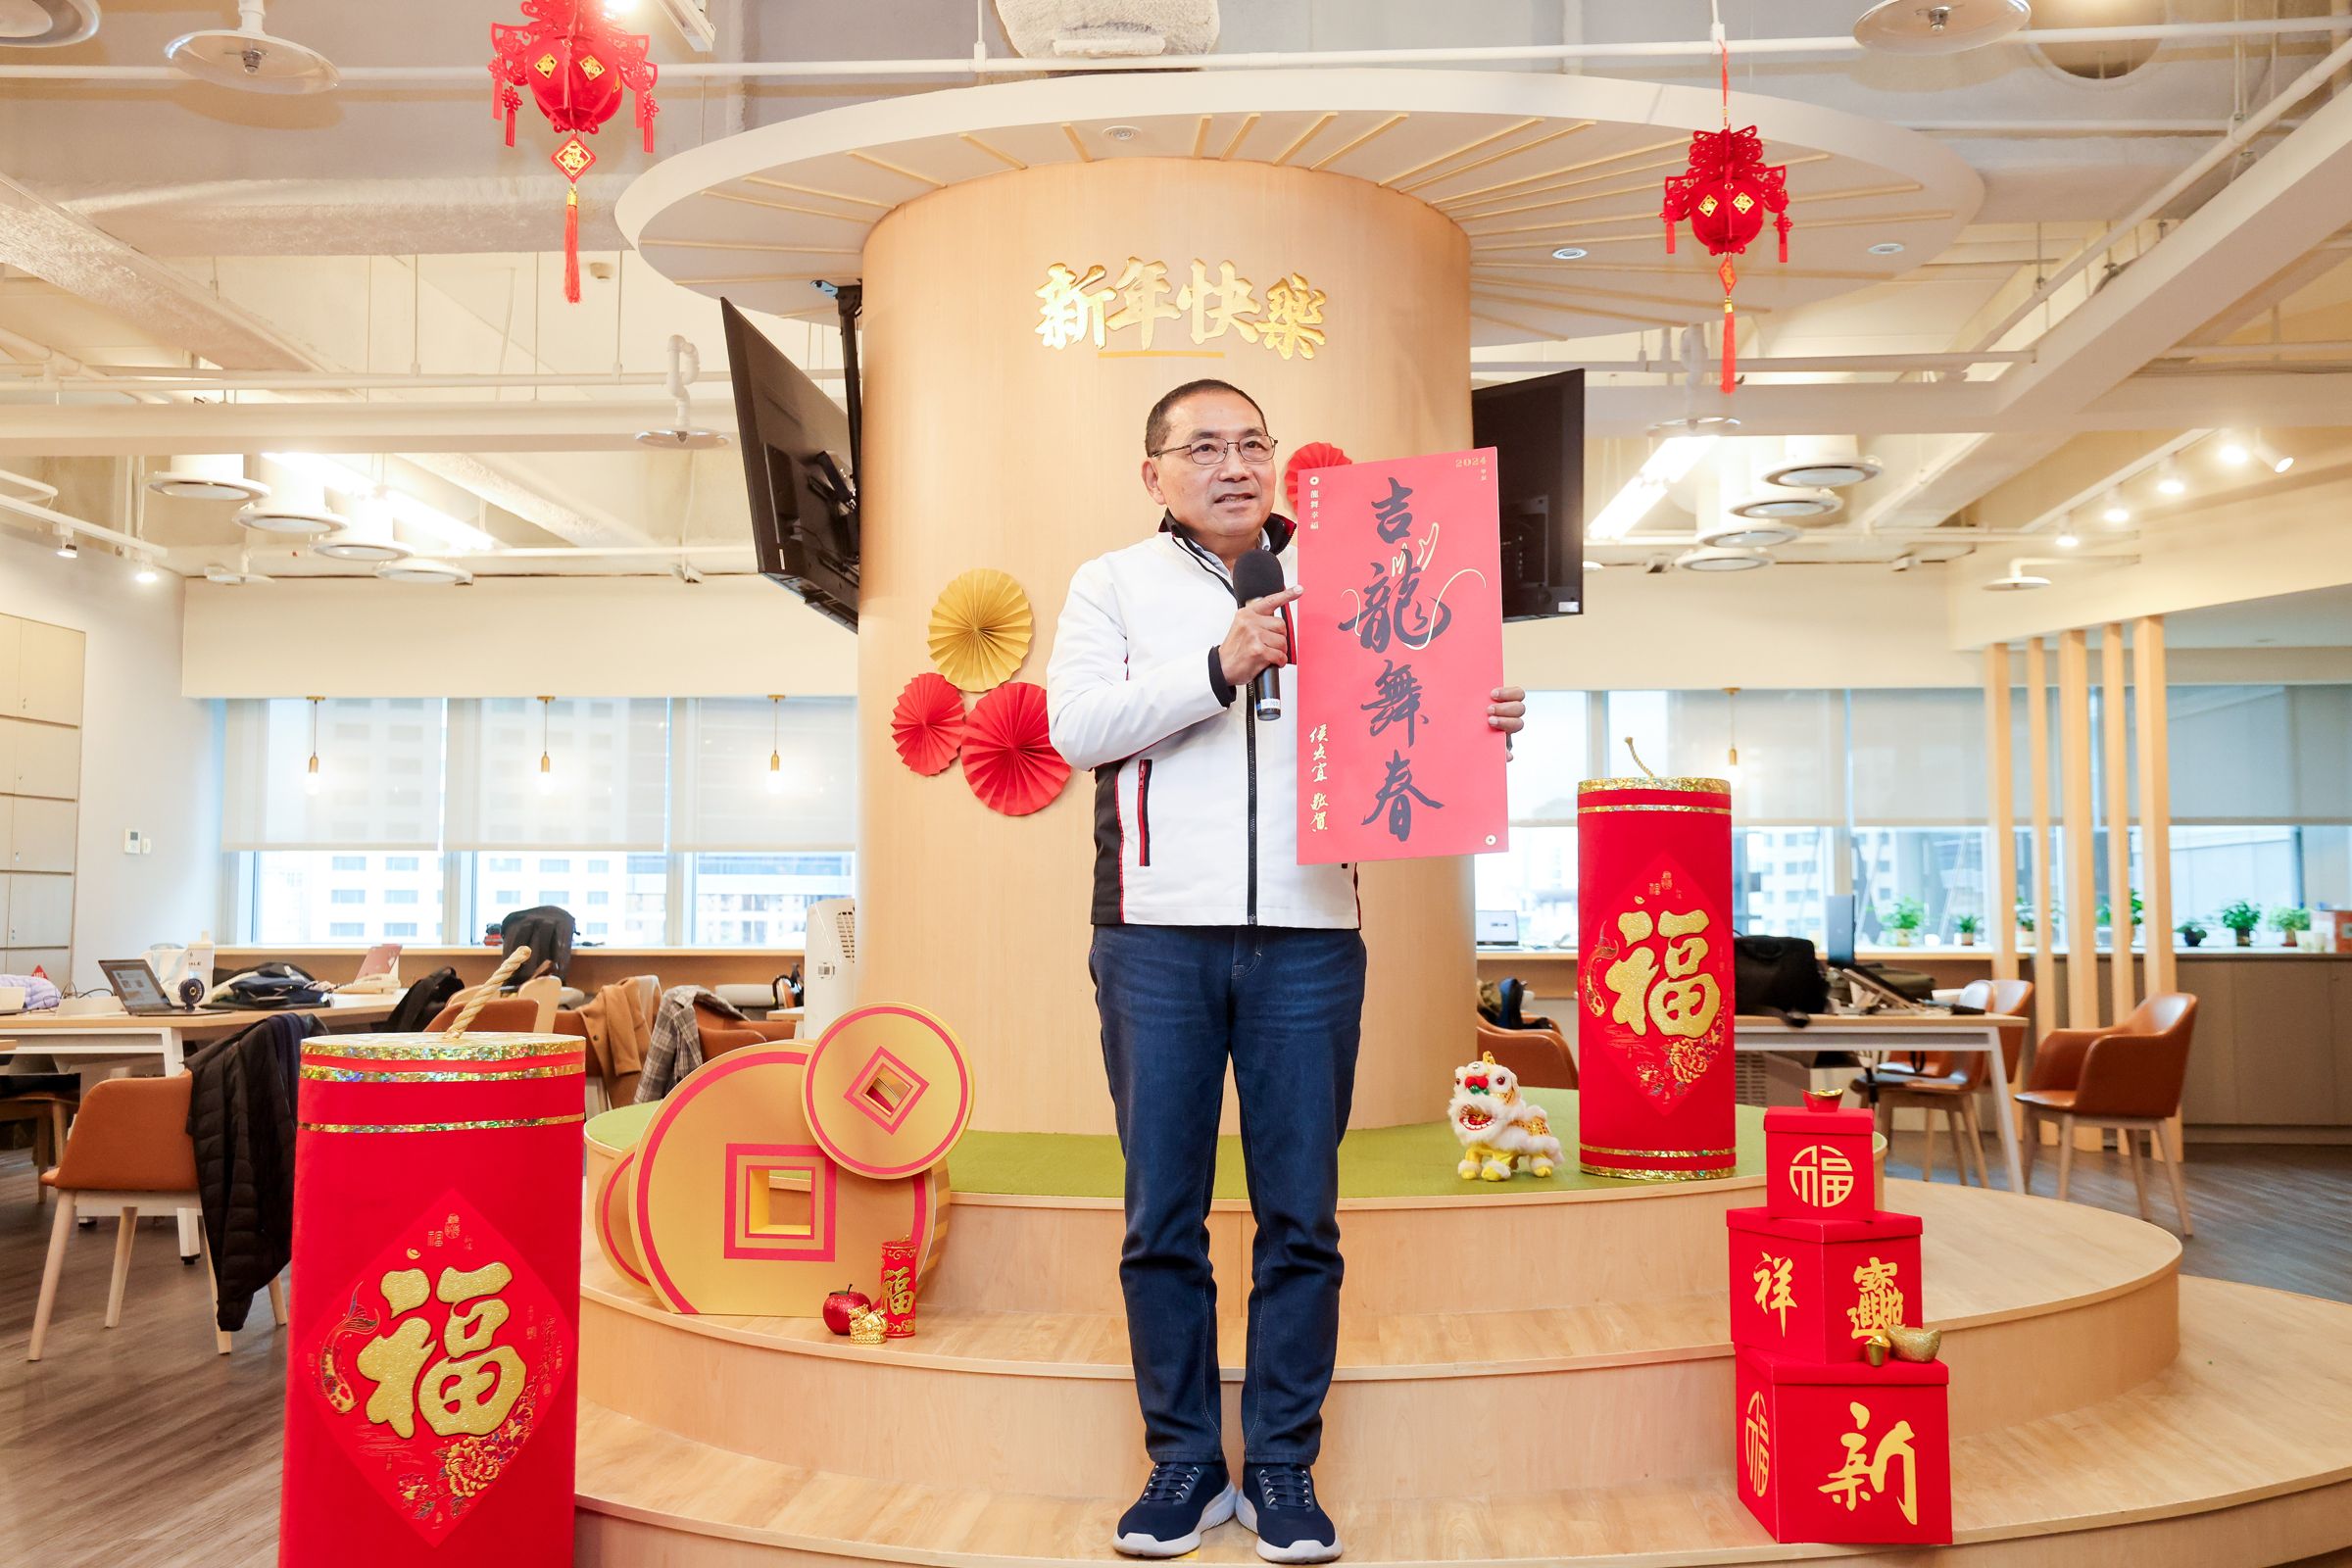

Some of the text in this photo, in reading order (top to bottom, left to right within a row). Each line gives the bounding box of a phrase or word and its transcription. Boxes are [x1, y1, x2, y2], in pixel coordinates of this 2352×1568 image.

[1034, 256, 1326, 360] 新年快樂
[1455, 456, 1487, 468] 2024
[1338, 476, 1452, 842] 吉龍舞春
[1309, 723, 1329, 783] 侯友宜
[1604, 909, 1721, 1039] 福
[1788, 1145, 1854, 1208] 福
[882, 1266, 916, 1316] 福
[1753, 1251, 1798, 1339] 祥
[357, 1261, 527, 1439] 福
[1745, 1391, 1770, 1497] 福
[1818, 1401, 1918, 1526] 新
